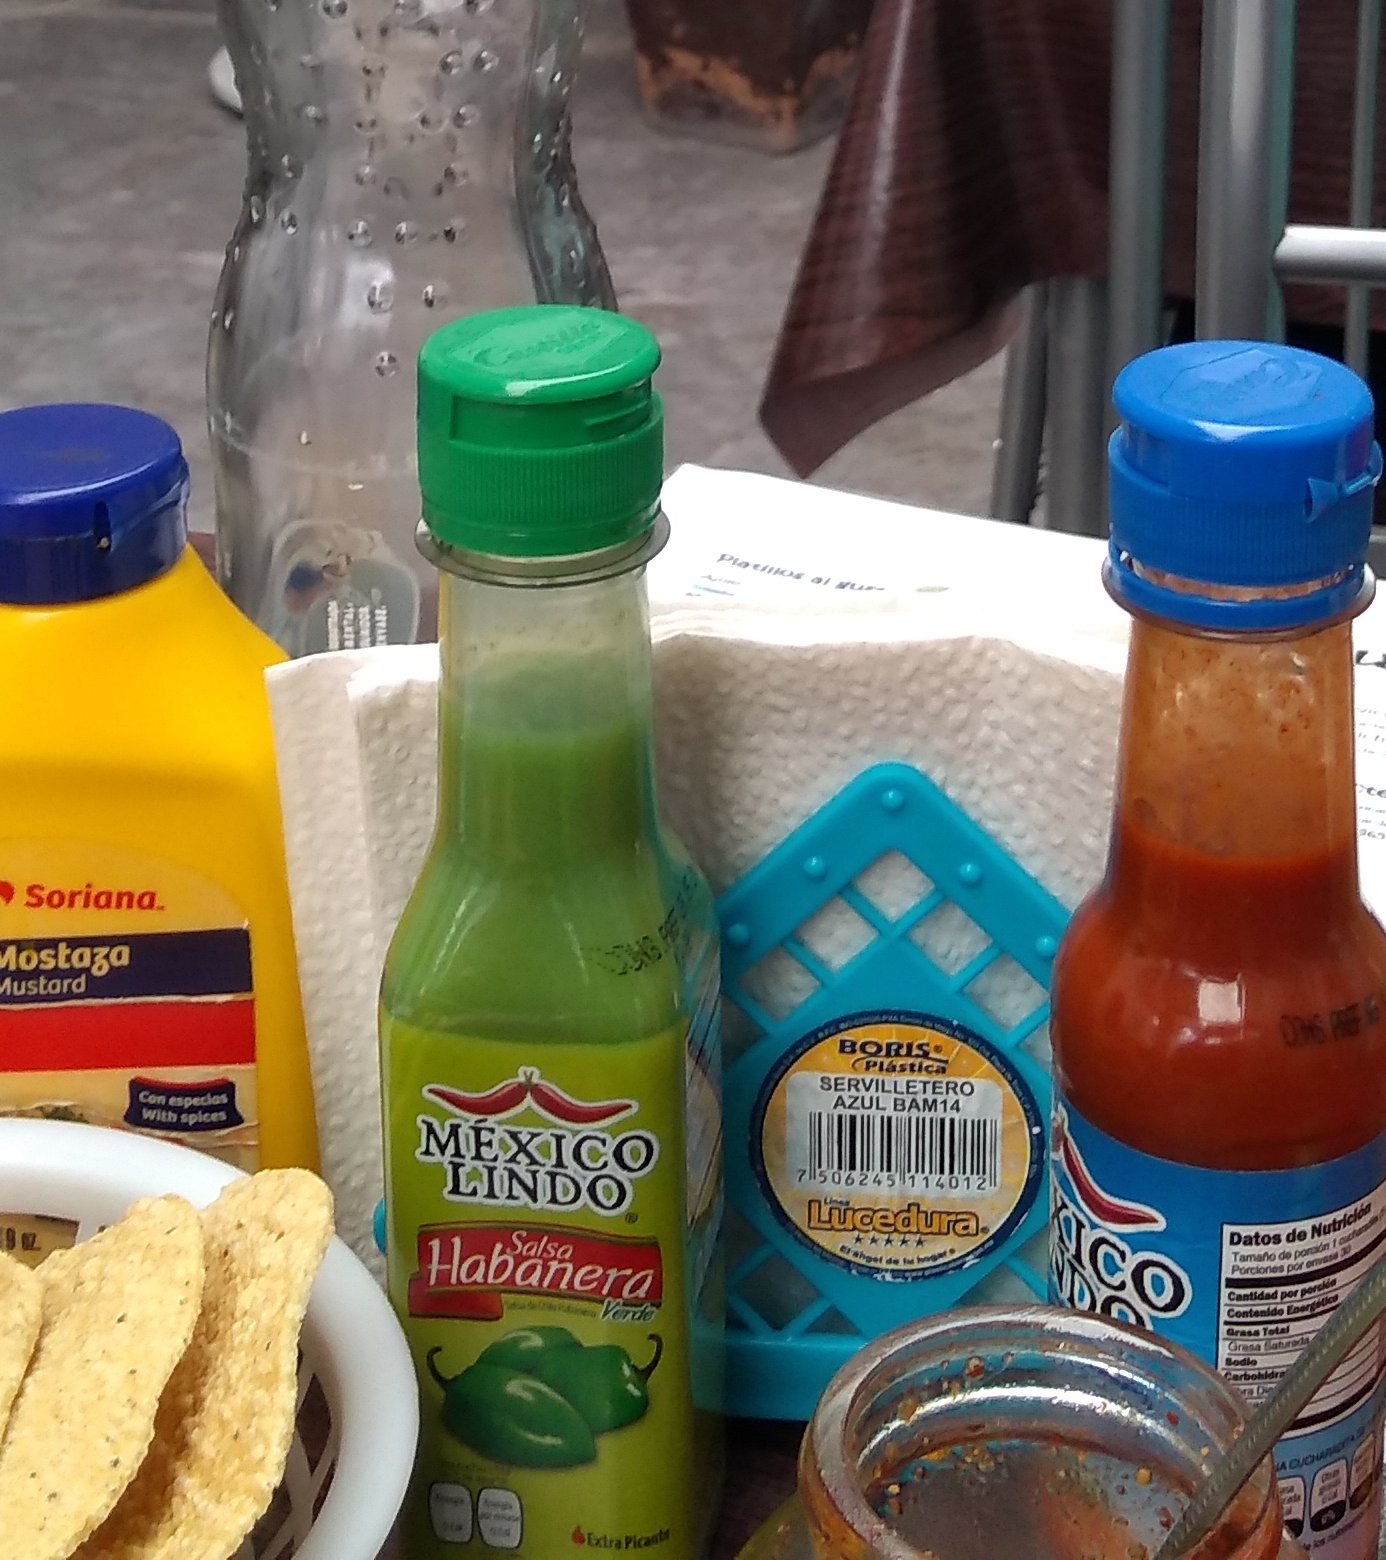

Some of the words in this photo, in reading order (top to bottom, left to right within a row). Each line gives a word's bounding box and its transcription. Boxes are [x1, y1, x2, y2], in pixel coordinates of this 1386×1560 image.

[24, 882, 158, 911] Soriana
[838, 1039, 930, 1057] BORIS
[819, 1075, 975, 1097] SERVILLETERO
[141, 1107, 178, 1124] With
[833, 1094, 887, 1112] AZUL
[893, 1097, 961, 1114] BAM14
[420, 1117, 656, 1174] MÉXICO
[446, 1161, 627, 1211] LINDO
[807, 1199, 980, 1237] Lucedura
[1229, 1231, 1282, 1247] Datos
[1286, 1228, 1308, 1244] de
[1311, 1202, 1373, 1241] Nutrición
[506, 1230, 574, 1260] Salsa
[1224, 1367, 1286, 1383] Carbohidra
